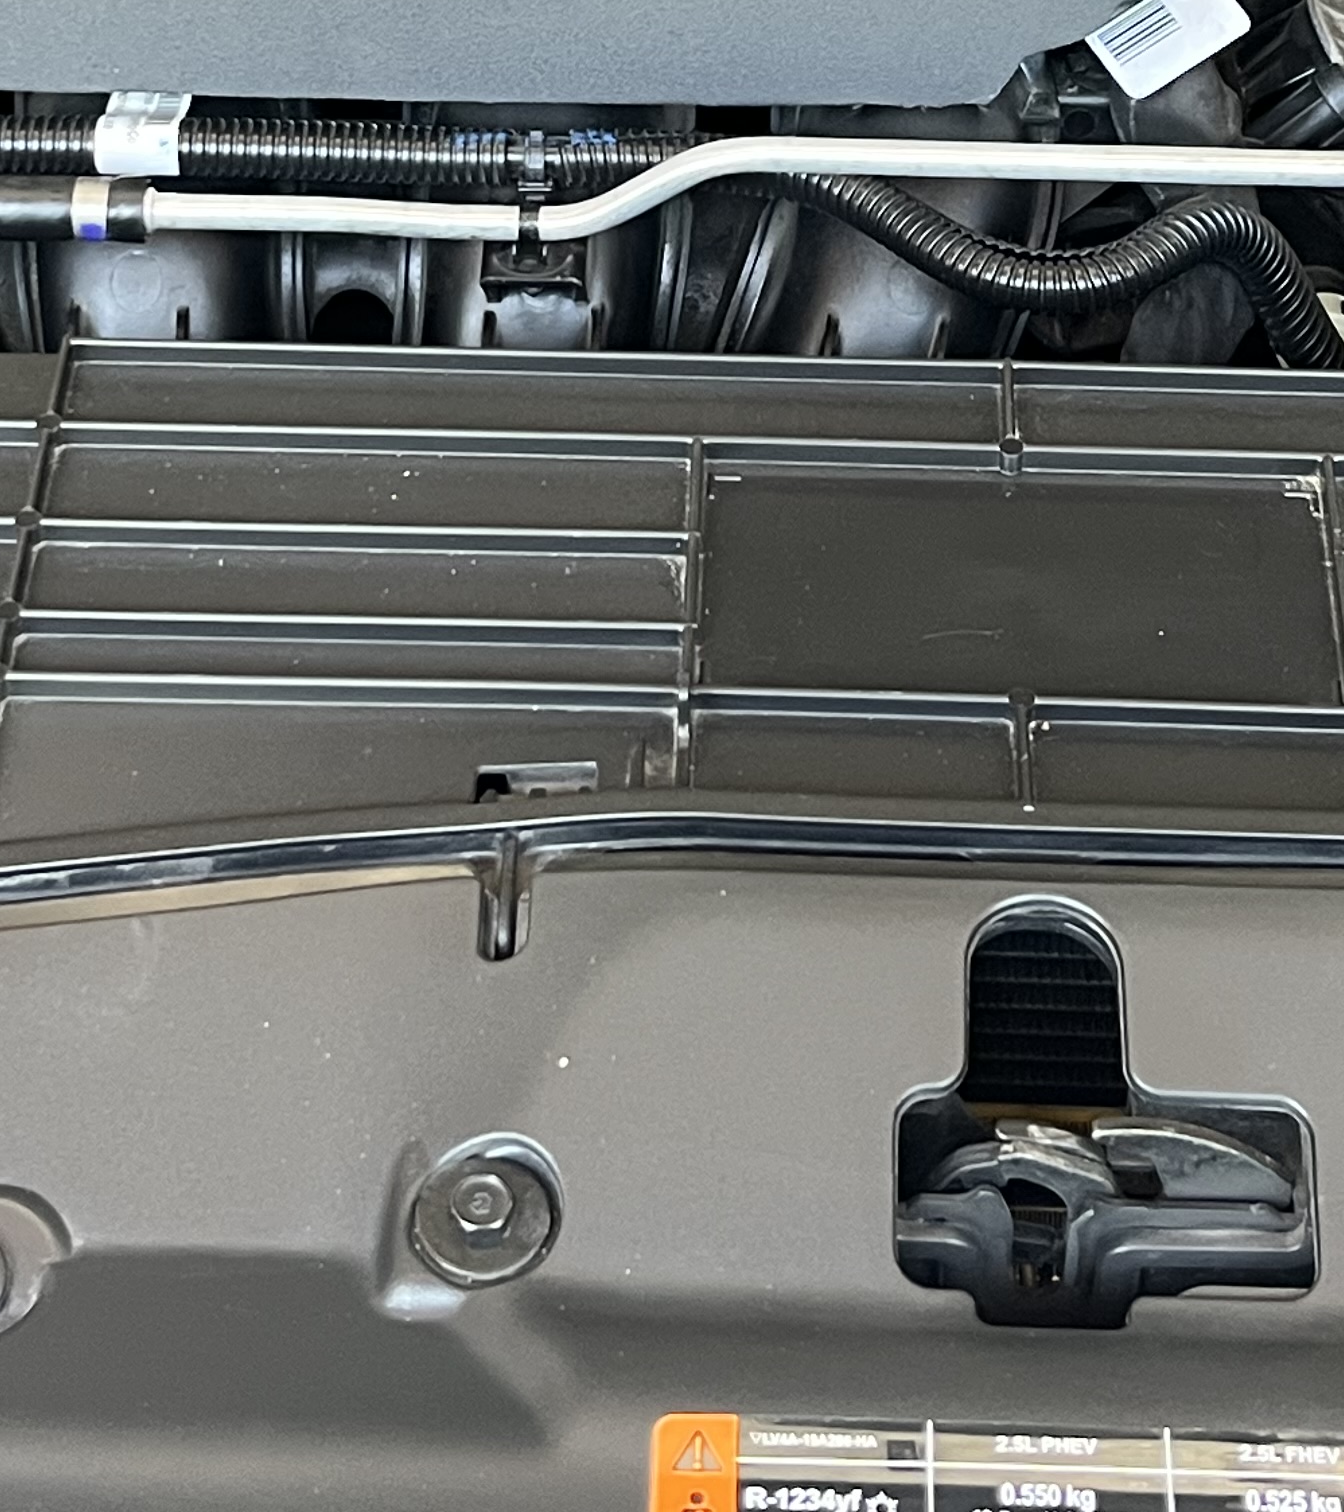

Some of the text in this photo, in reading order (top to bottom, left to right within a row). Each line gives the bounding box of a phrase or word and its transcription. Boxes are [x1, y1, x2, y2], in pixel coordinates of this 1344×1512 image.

[994, 1434, 1098, 1456] 2.5L PHEV
[1238, 1443, 1341, 1465] 2.5L FHEV
[744, 1486, 863, 1512] R-1234yf
[1000, 1482, 1097, 1512] 0.550 kg
[1244, 1489, 1308, 1512] 0.525
